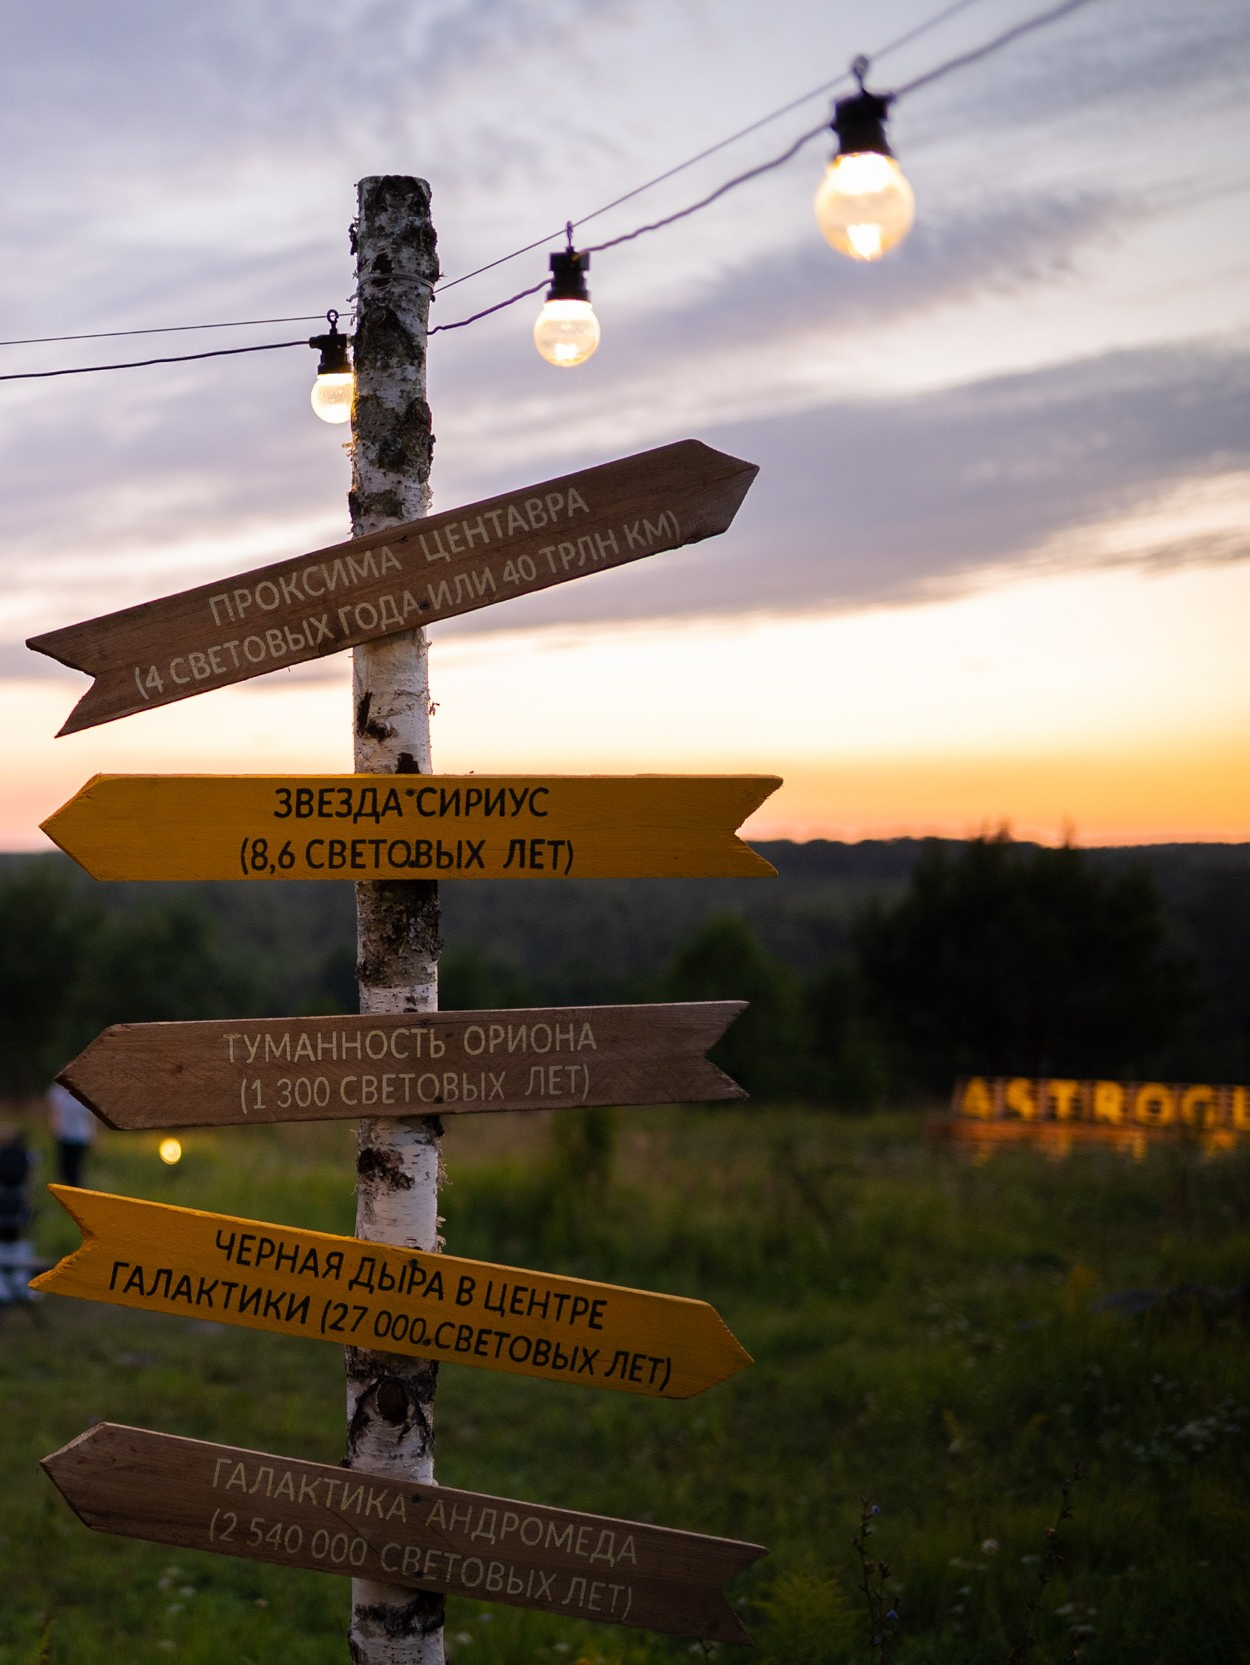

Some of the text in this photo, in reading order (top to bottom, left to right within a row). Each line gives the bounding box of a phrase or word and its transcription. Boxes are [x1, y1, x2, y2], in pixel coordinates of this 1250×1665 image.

[134, 510, 682, 699] (4 СВЕТОВЫХ ГОДА ИЛИ 40 ТРЛН КМ)
[208, 486, 590, 627] ПРОКСИМА ЦЕНТАВРА
[240, 837, 574, 875] (8,6 СВЕТОВЫХ ЛЕТ)
[273, 786, 550, 824] ЗВЕЗДА СИРИУС
[223, 1022, 597, 1064] ТУМАННОСТЬ ОРИОНА
[240, 1064, 590, 1113] (1 300 СВЕТОВЫХ ЛЕТ)
[109, 1261, 671, 1391] ГАЛАКТИКИ (27 000 СВЕТОВЫХ ЛЕТ)
[215, 1229, 607, 1331] ЧЕРНАЯ ДЫРА В ЦЕНТРЕ
[210, 1508, 633, 1621] (2 540 000 СВЕТОВЫХ ЛЕТ)
[212, 1457, 638, 1567] ГАЛАКТИКА АНДРОМЕДА
